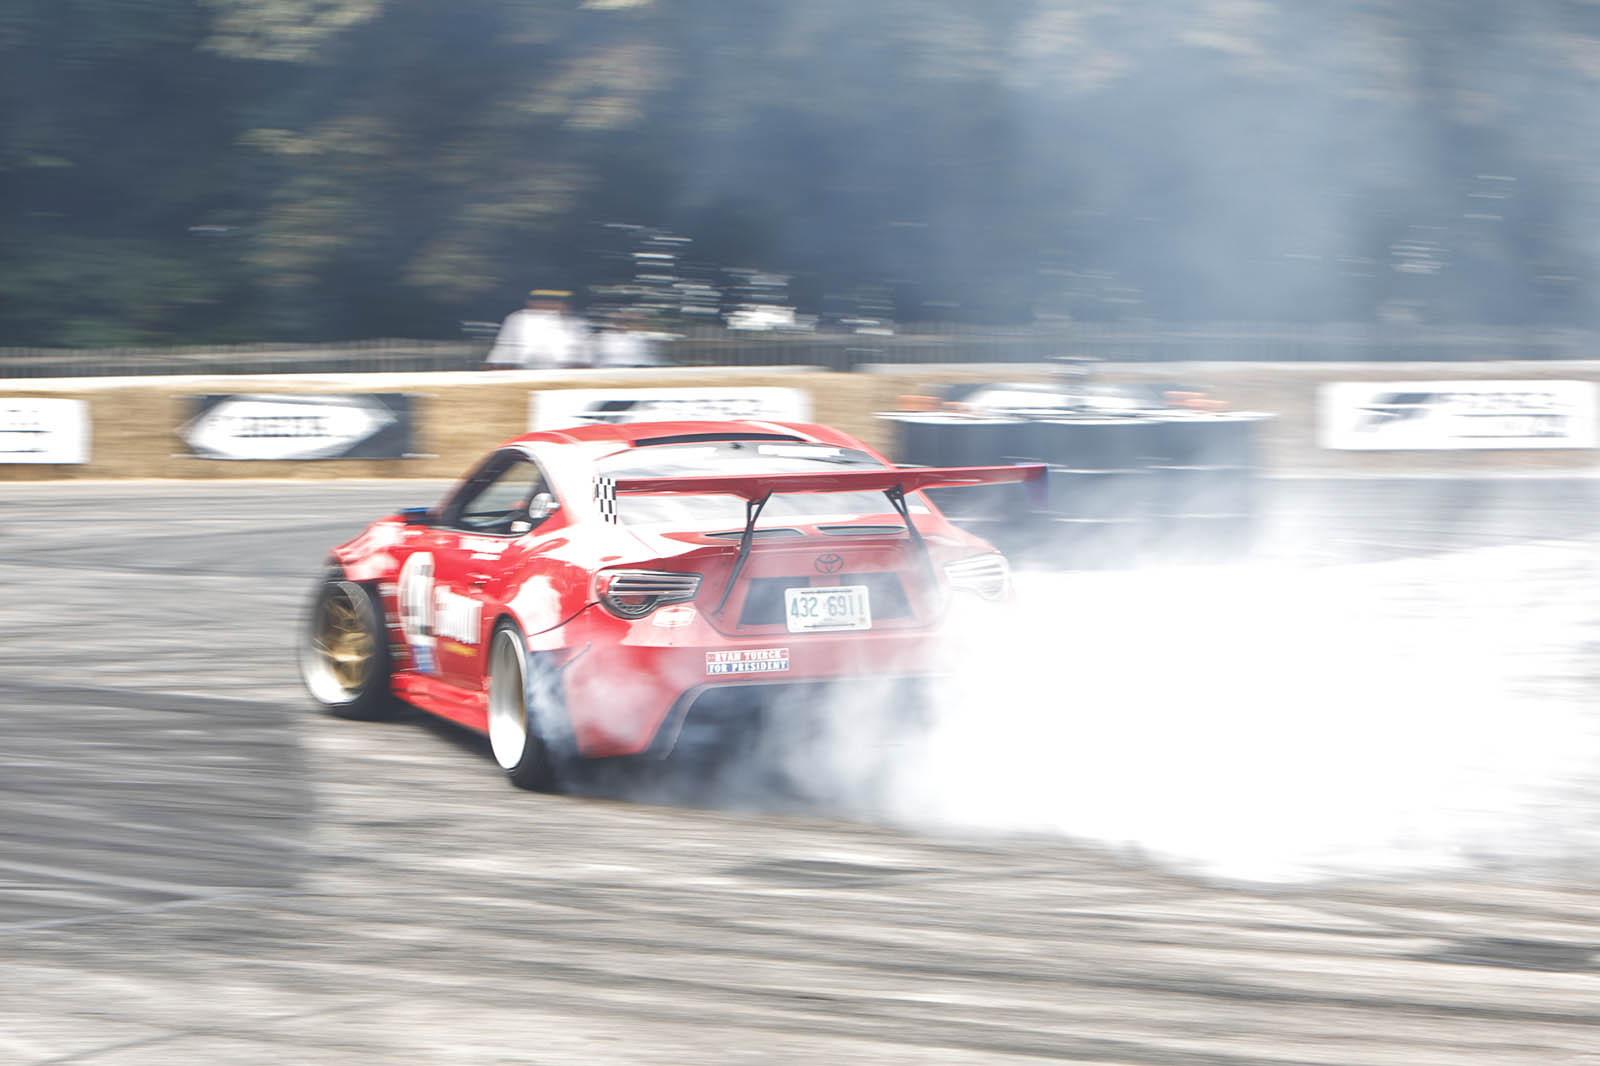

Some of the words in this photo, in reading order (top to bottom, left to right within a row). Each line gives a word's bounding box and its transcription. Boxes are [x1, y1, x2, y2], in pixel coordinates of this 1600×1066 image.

[791, 596, 820, 617] 432
[715, 652, 741, 662] RYAN
[708, 663, 728, 674] FOR
[732, 661, 787, 672] PRESIDENT
